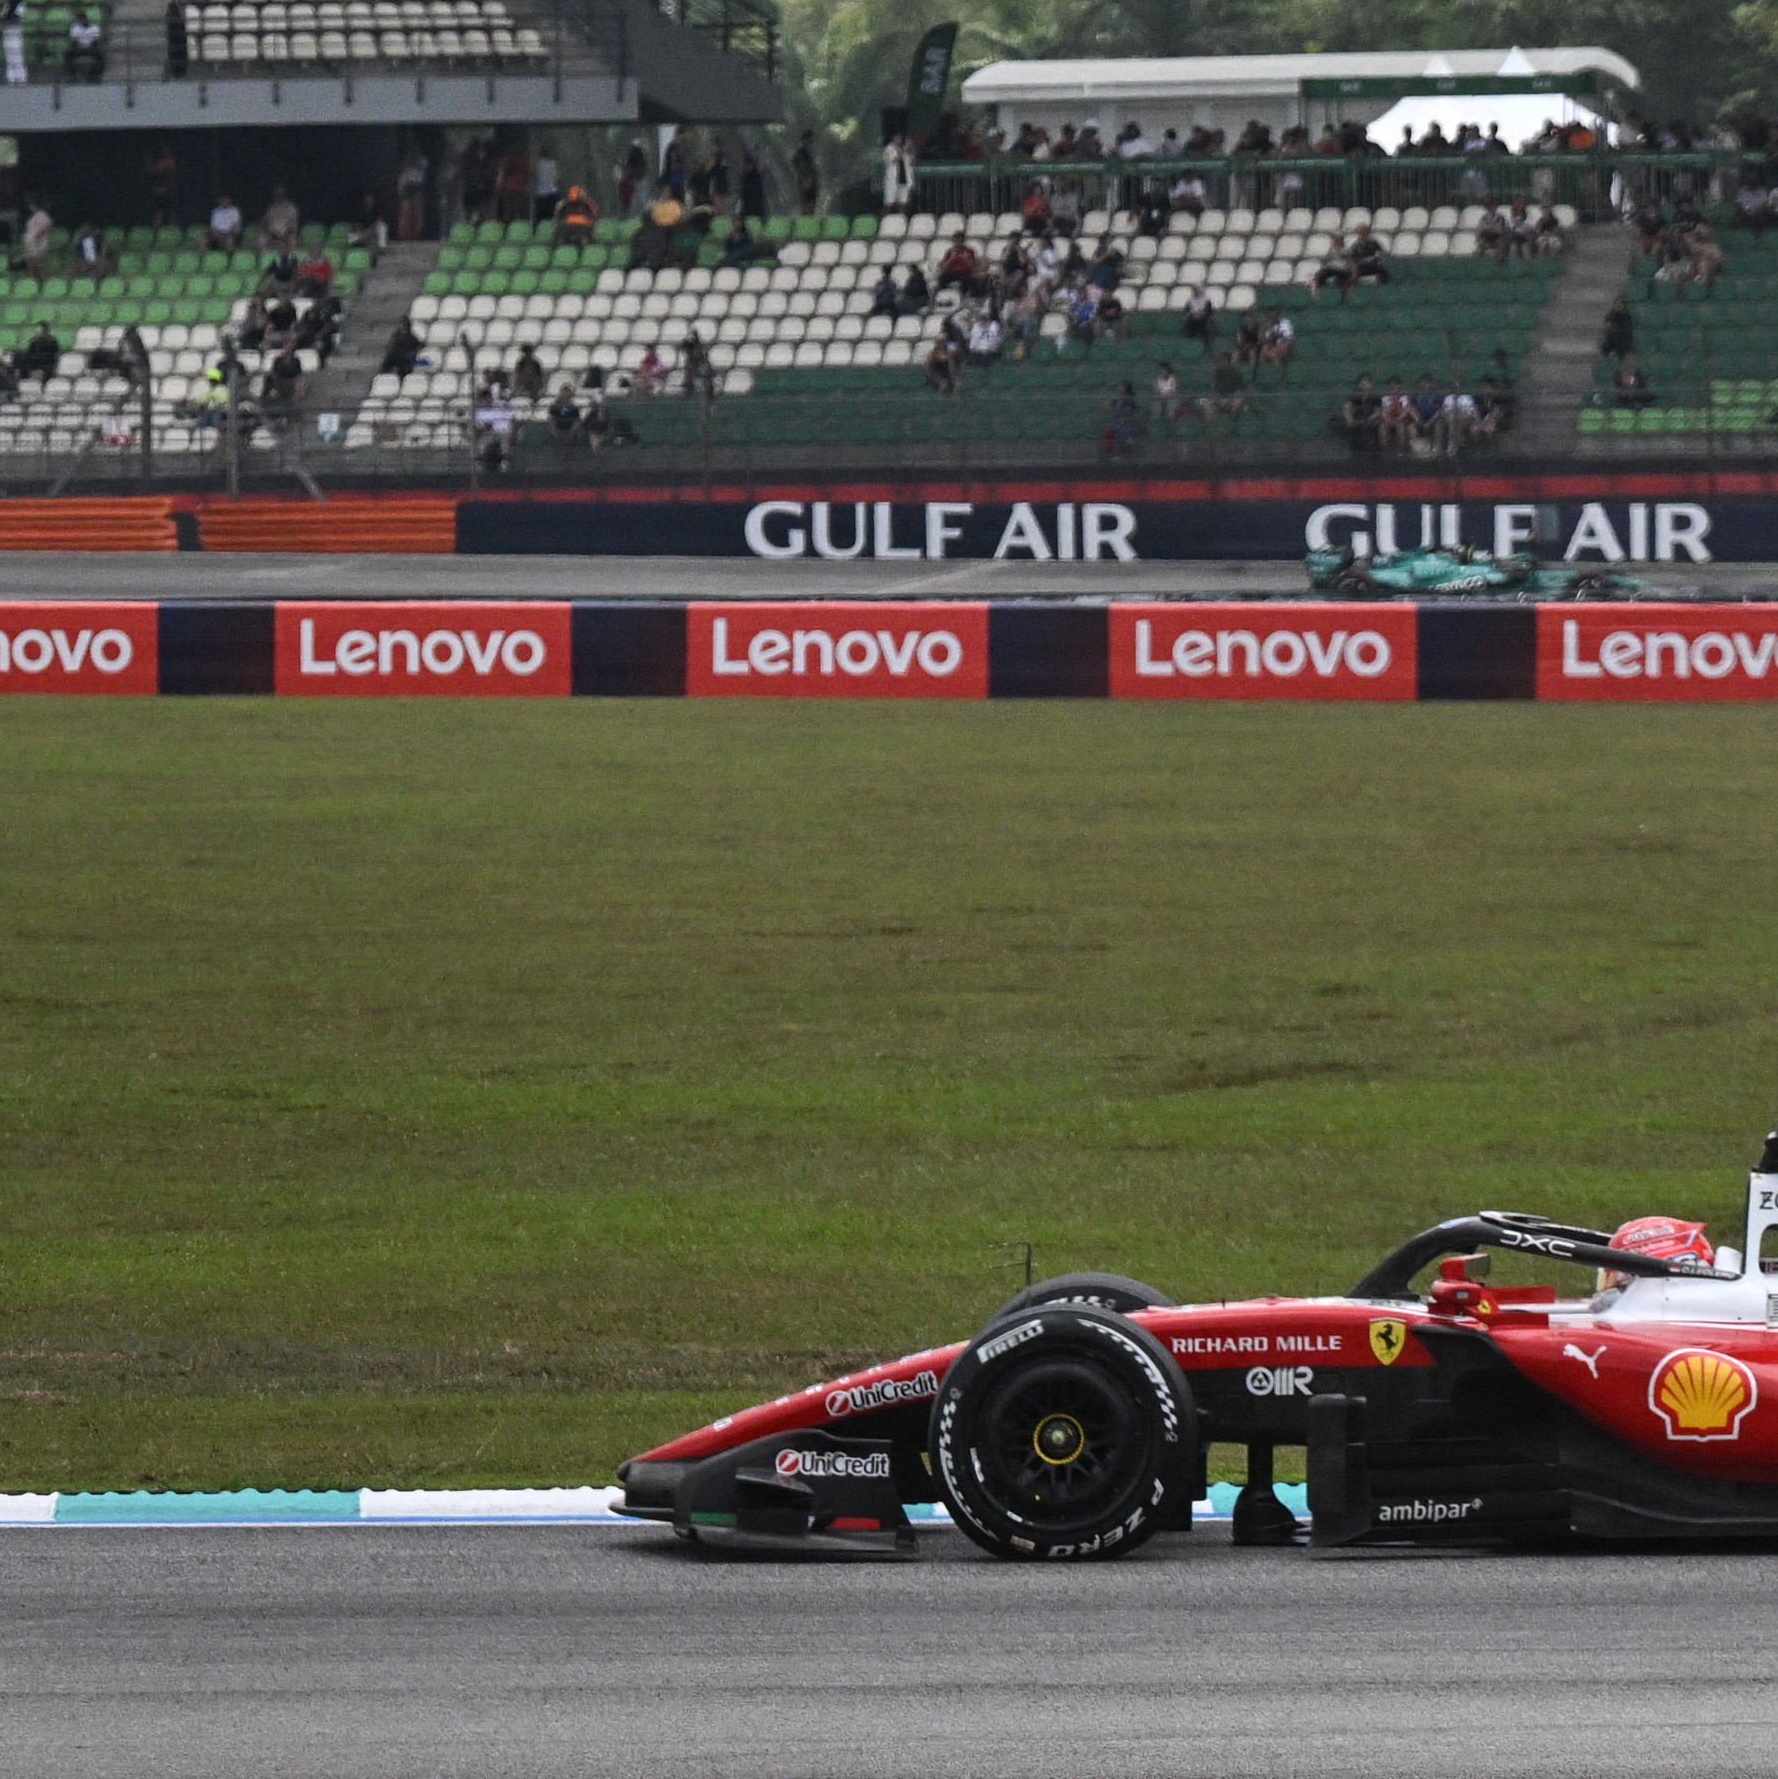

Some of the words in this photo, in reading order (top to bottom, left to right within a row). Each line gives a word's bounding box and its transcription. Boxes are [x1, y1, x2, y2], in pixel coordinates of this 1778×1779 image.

[744, 501, 973, 560] GULF
[994, 501, 1138, 561] AIR
[1564, 502, 1712, 562] AIR
[301, 616, 545, 674] Lenovo
[713, 617, 961, 675] Lenovo
[1136, 617, 1389, 676] Lenovo
[976, 1319, 1045, 1364] PIRELLI
[1171, 1336, 1269, 1353] RICHARD
[1276, 1335, 1343, 1352] MILLE
[850, 1371, 939, 1410] UniCredit
[800, 1451, 890, 1478] UniCredit
[1150, 1477, 1165, 1506] P
[1047, 1506, 1146, 1557] ZERO
